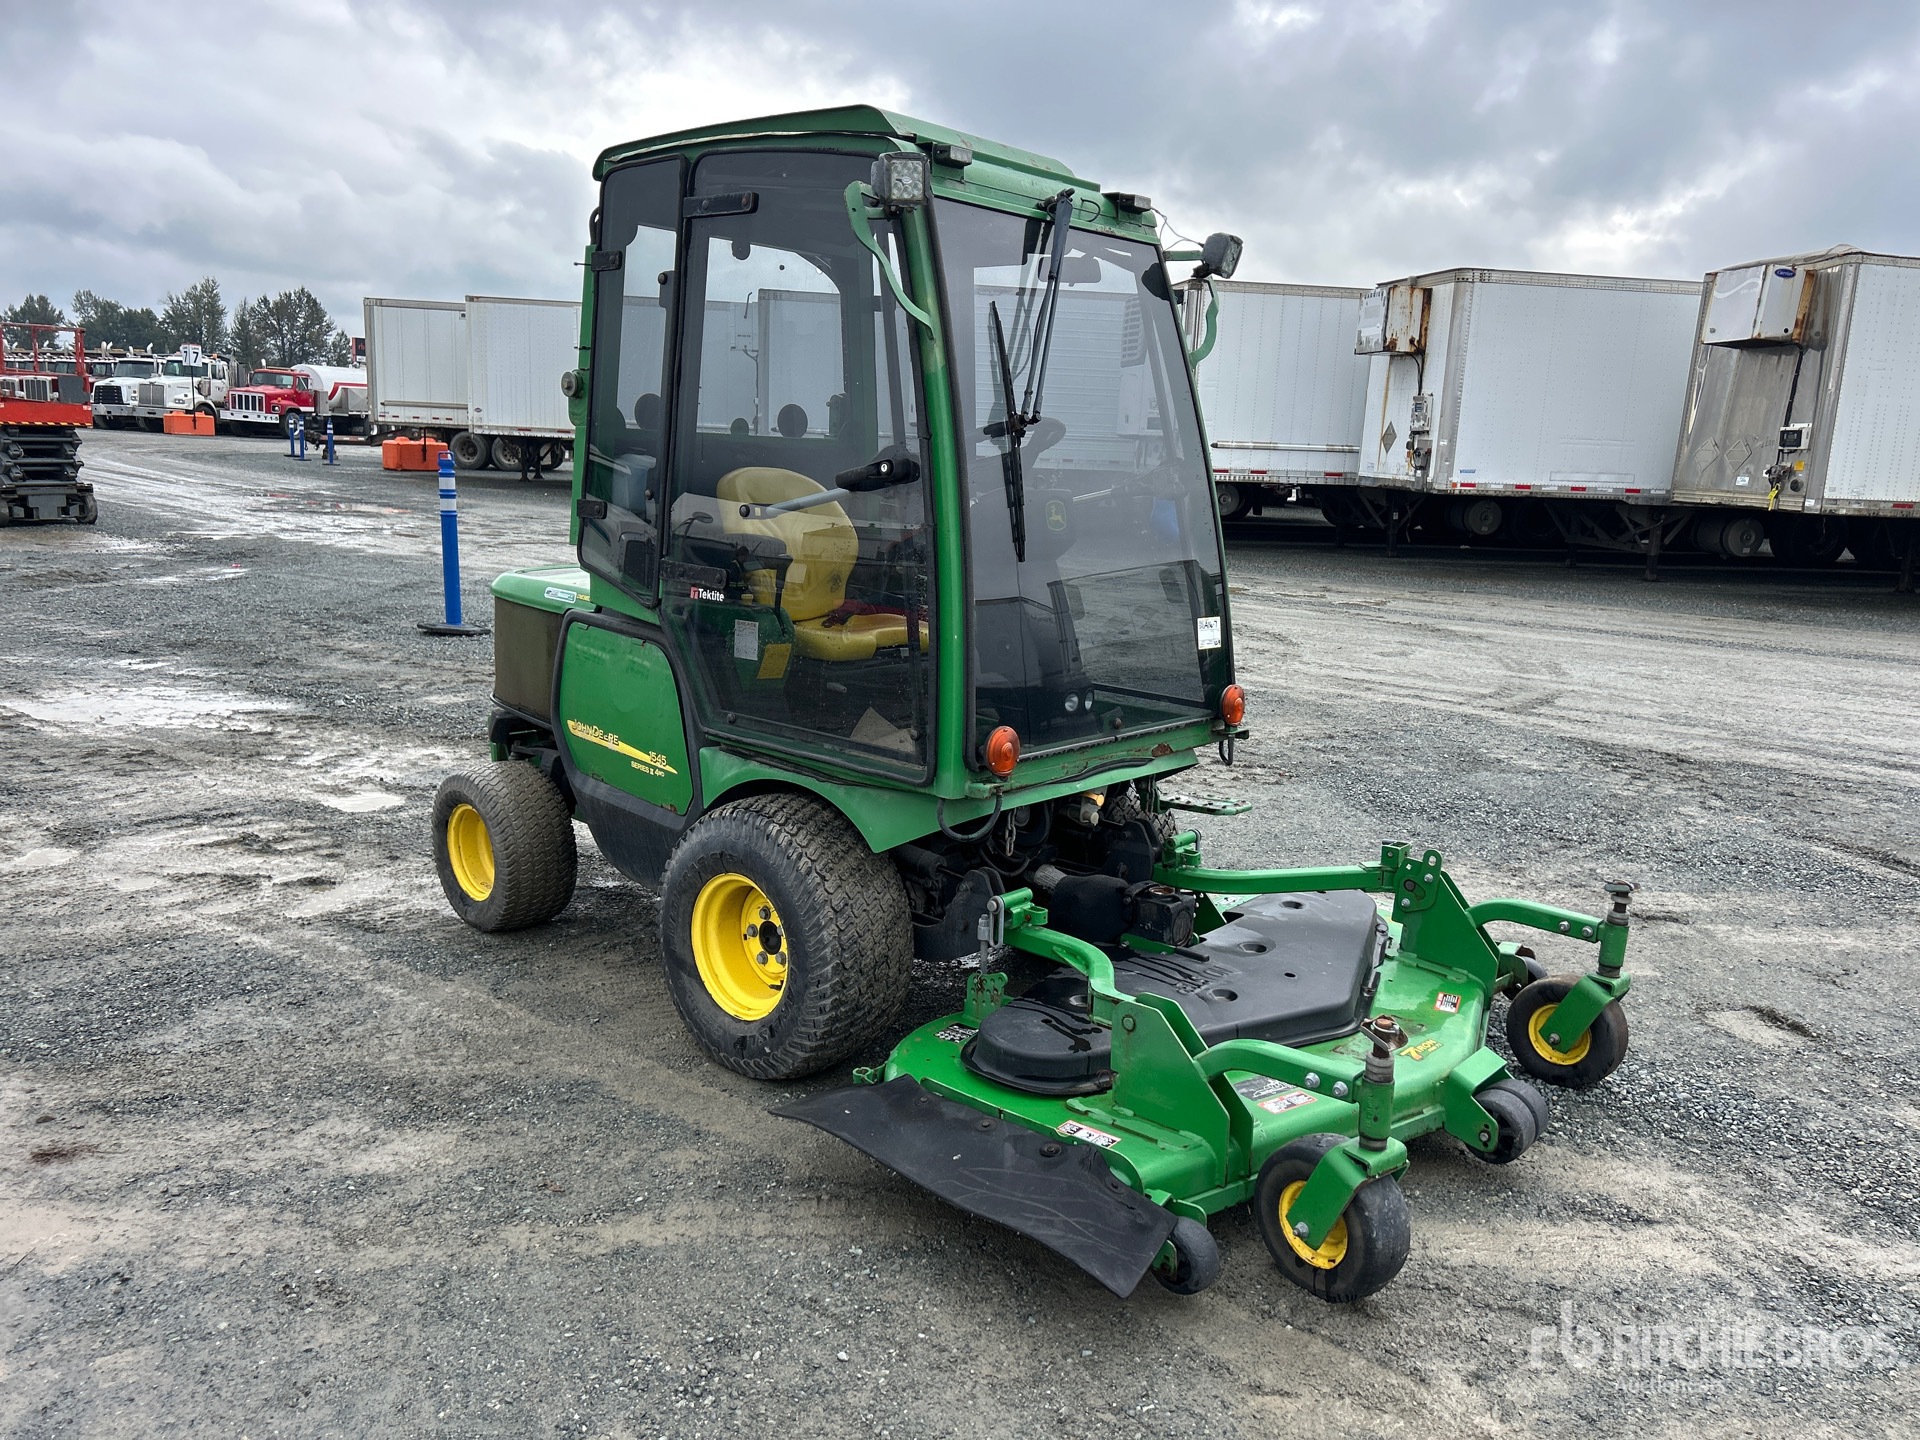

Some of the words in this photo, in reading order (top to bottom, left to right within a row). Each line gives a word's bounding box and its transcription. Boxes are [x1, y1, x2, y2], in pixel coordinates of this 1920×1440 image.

[192, 351, 199, 363] 7
[698, 588, 725, 602] Tektite
[648, 751, 667, 766] 1545
[630, 761, 650, 774] SERIES
